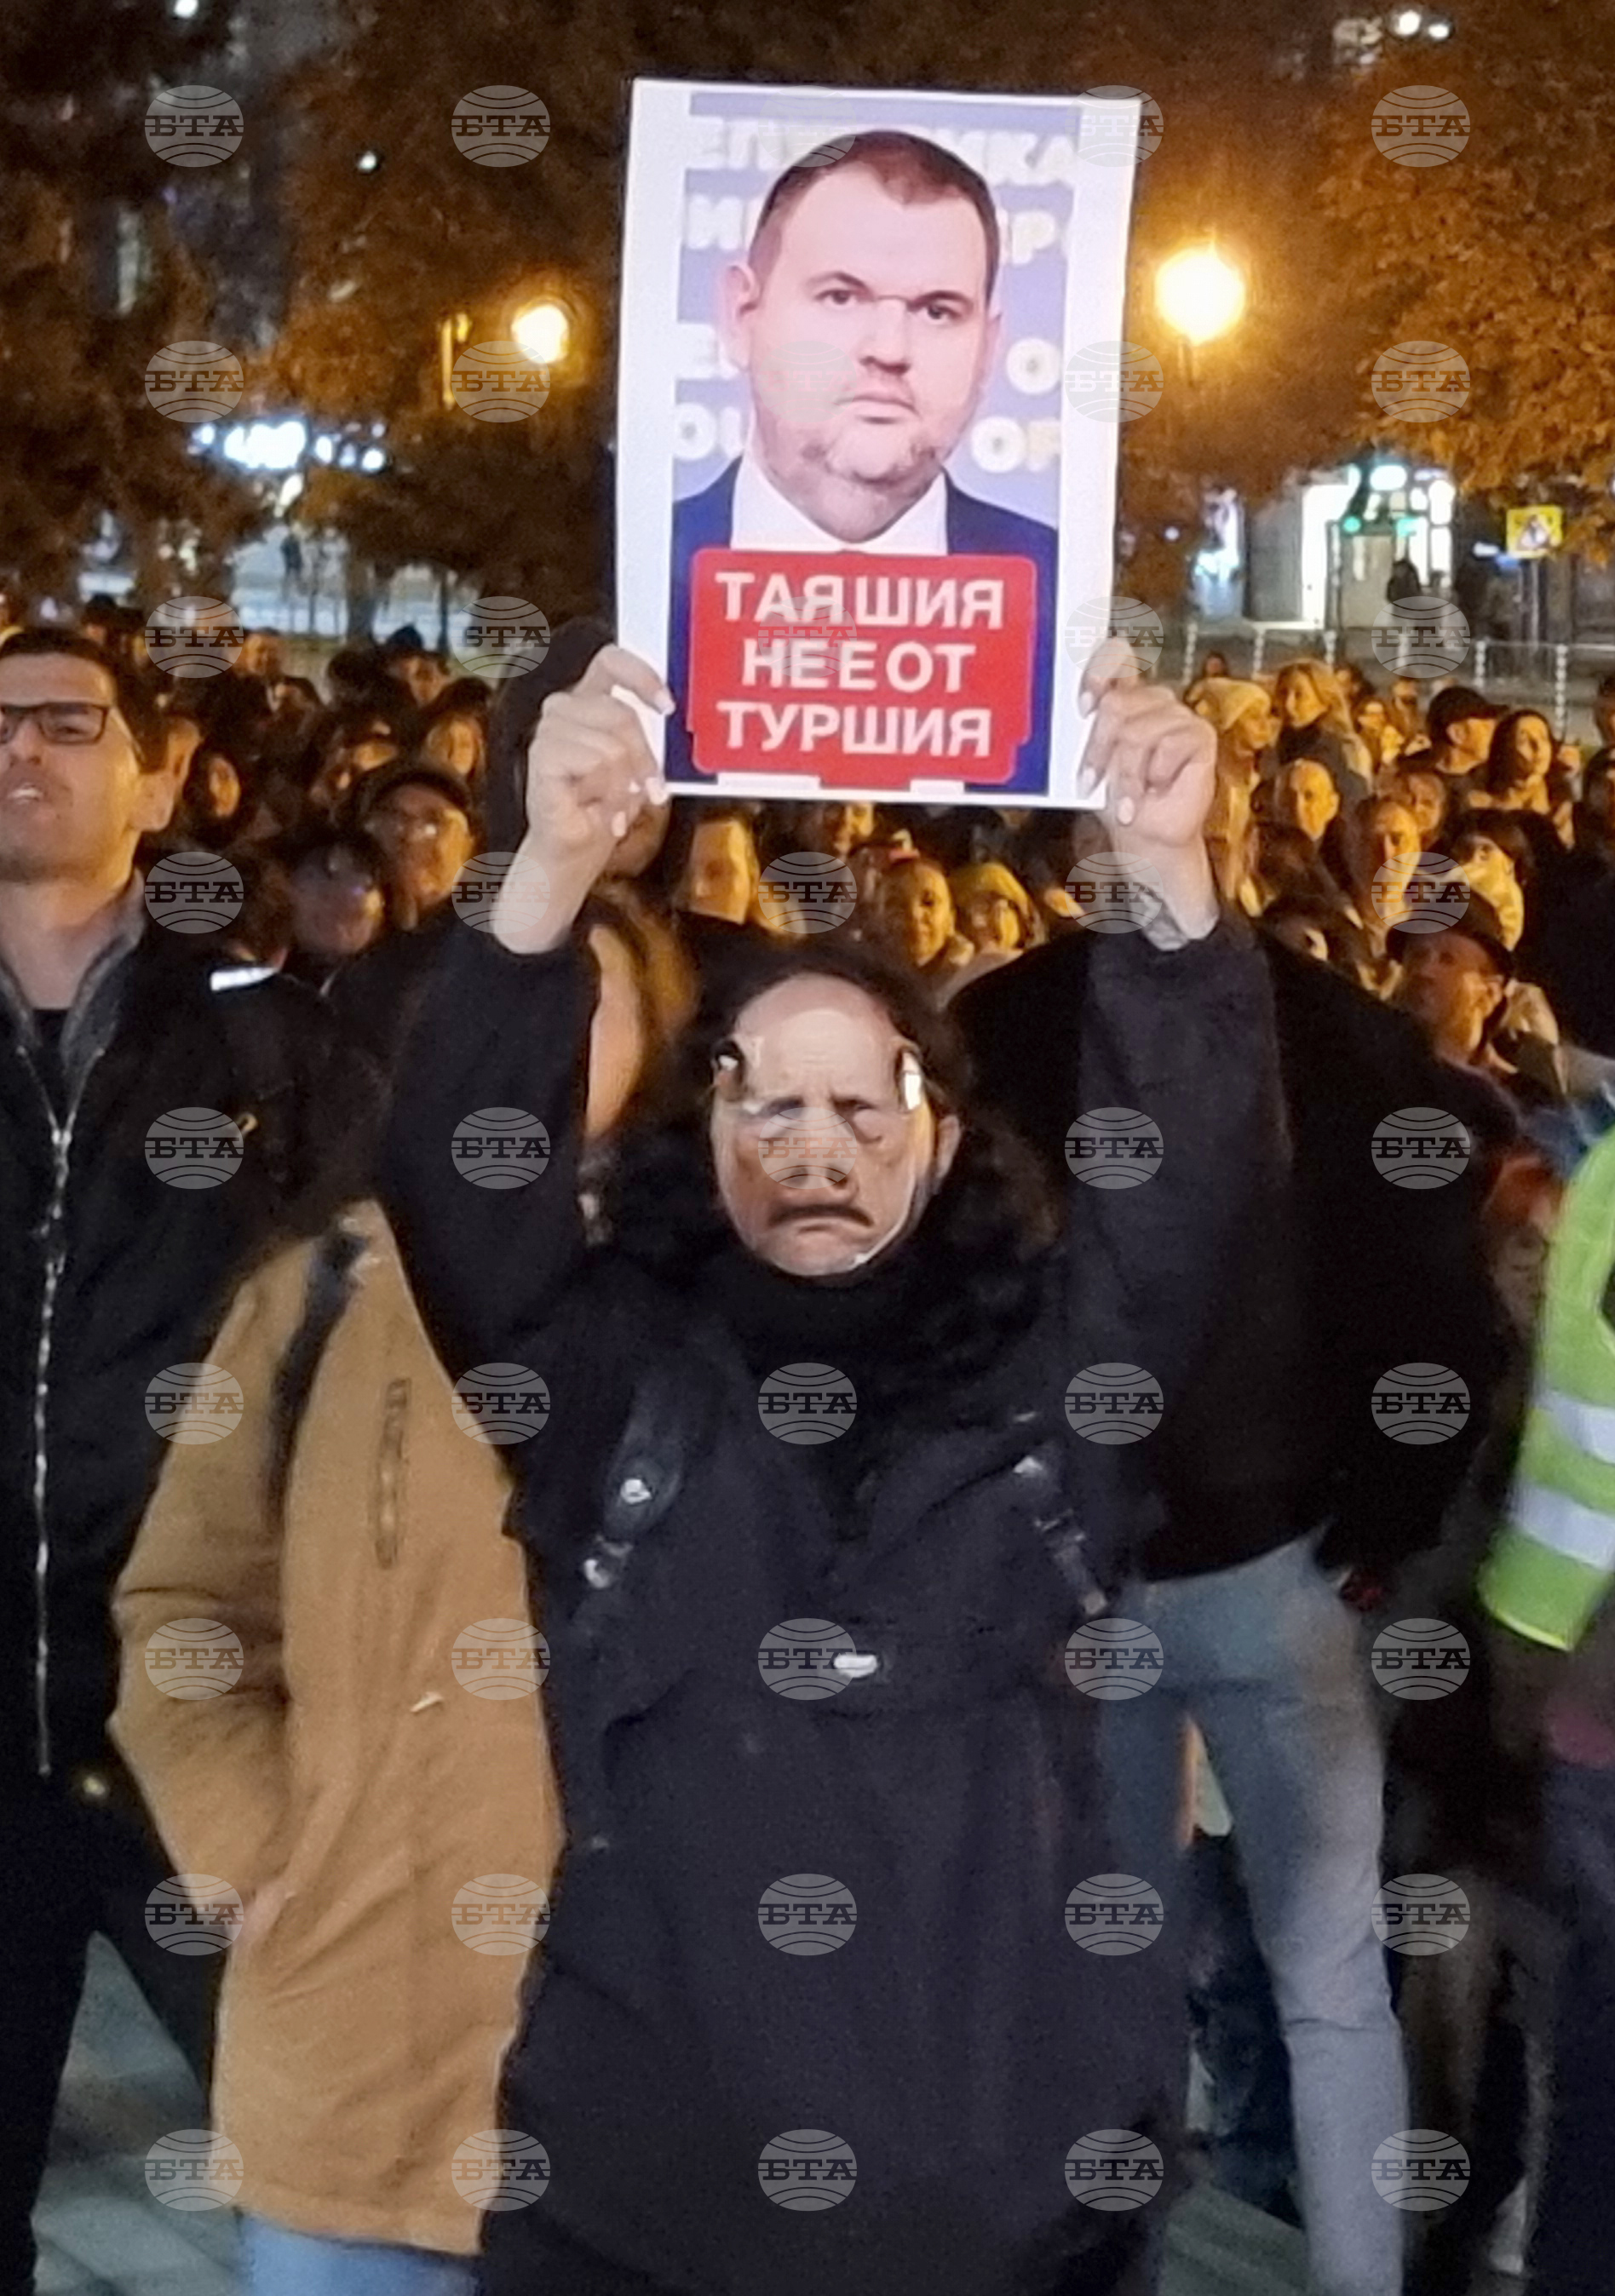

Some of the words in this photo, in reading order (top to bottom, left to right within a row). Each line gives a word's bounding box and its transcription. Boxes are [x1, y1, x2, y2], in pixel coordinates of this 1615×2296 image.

[715, 571, 844, 624] ТАЯ
[855, 577, 1004, 629] ШИЯ
[886, 641, 976, 692] ОТ
[716, 700, 991, 757] ТУРШИЯ
